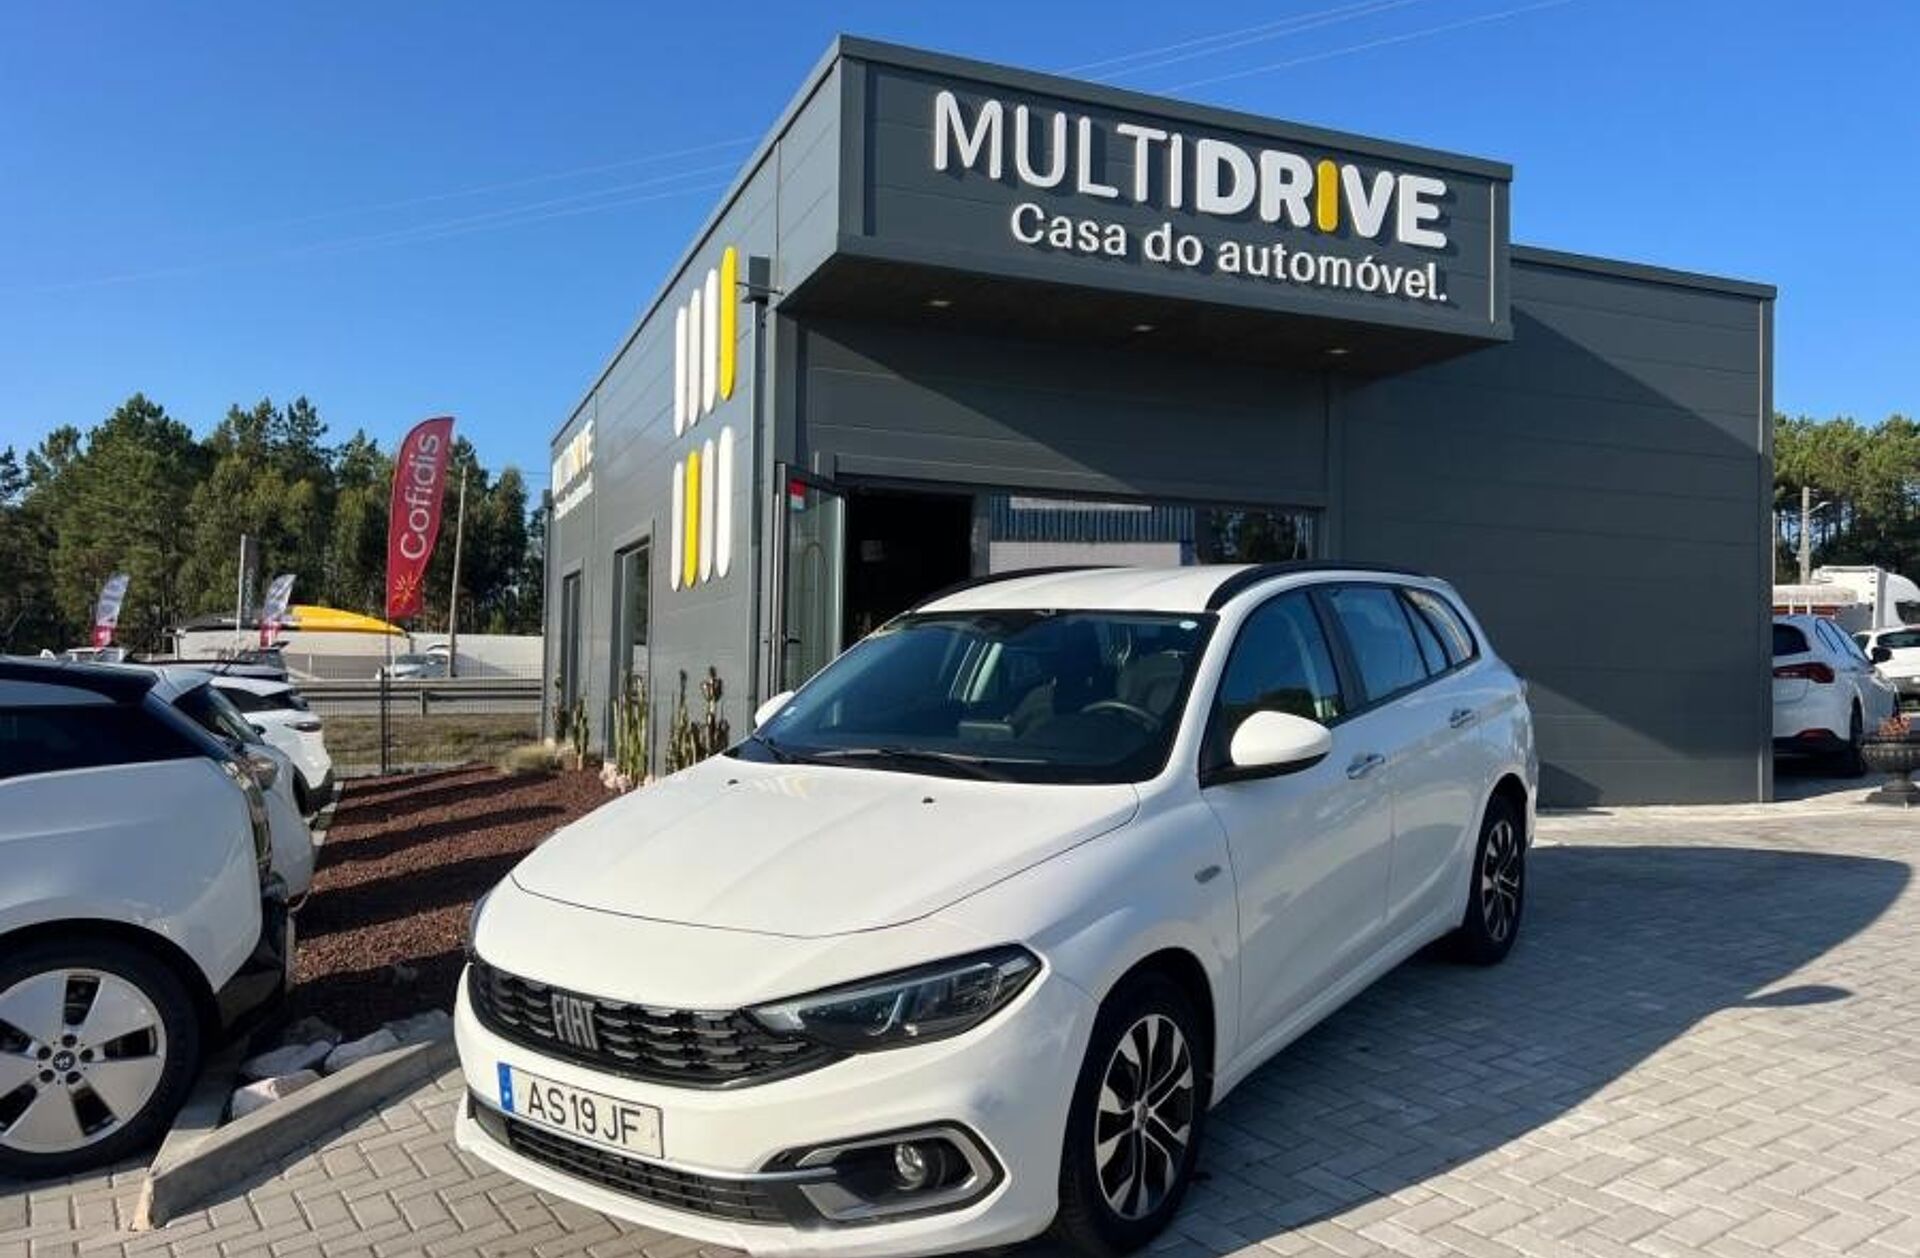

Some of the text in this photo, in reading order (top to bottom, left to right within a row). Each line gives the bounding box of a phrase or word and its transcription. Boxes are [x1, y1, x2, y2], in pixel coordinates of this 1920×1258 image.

[934, 90, 1448, 249] MULTIDRIVE
[1011, 203, 1448, 301] Casa do automóvel.
[400, 433, 440, 559] Cofidis
[552, 993, 598, 1050] FIAT
